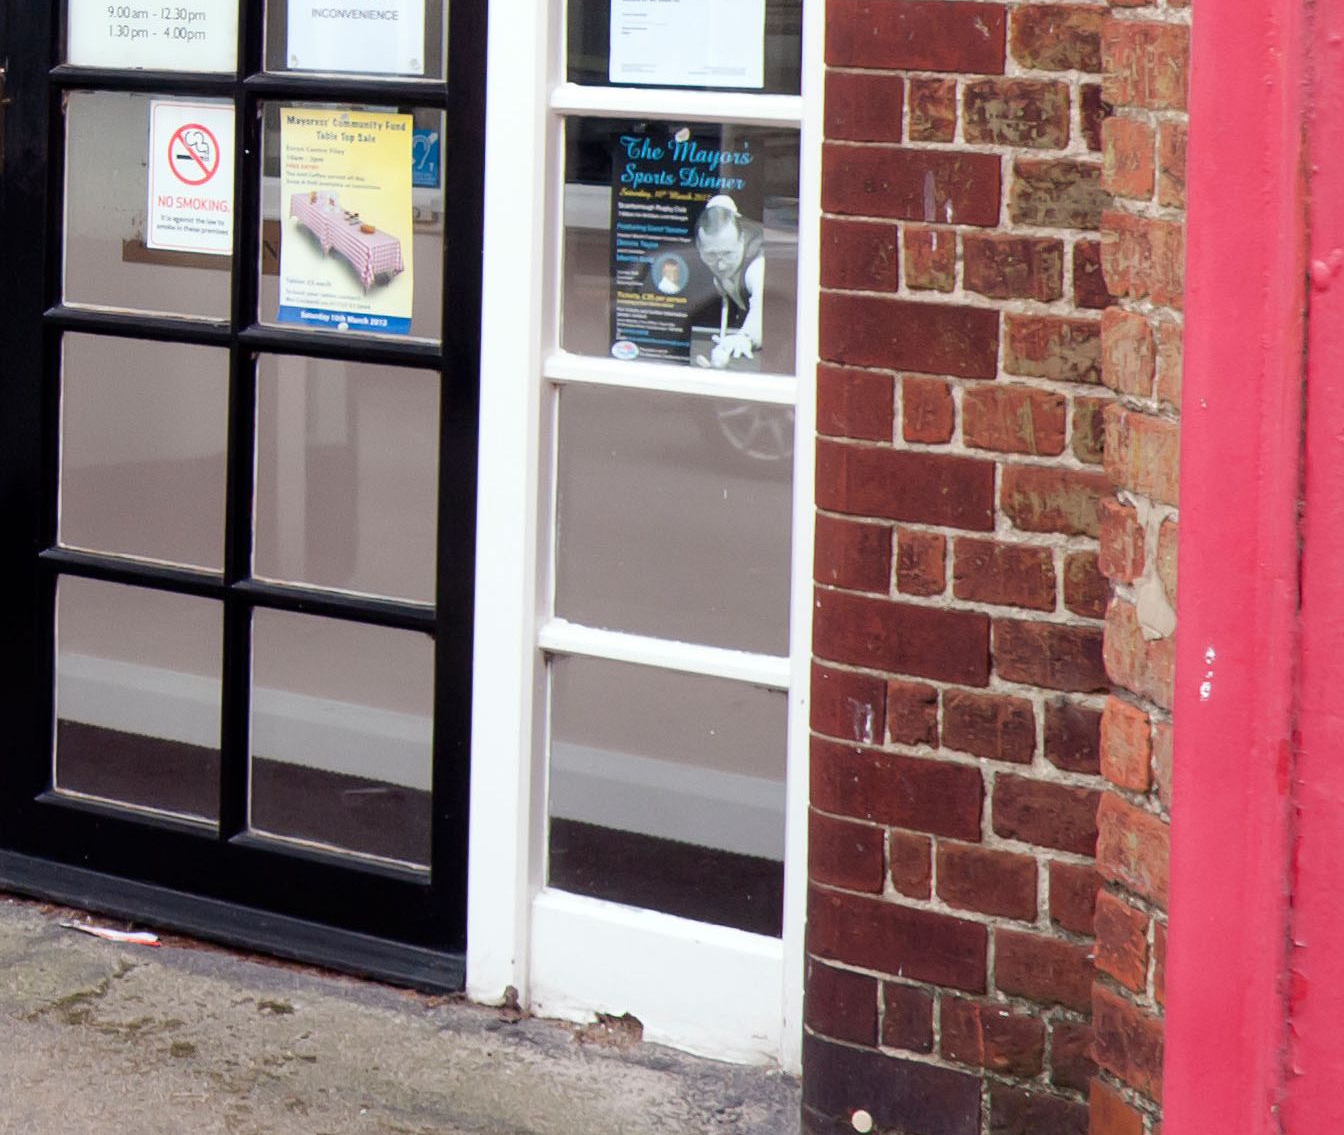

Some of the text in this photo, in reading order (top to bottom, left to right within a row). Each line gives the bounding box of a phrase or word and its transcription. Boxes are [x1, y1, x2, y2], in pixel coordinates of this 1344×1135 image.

[311, 8, 399, 21] INCONVENIENCE
[332, 118, 382, 130] Community
[385, 121, 406, 131] Fund
[316, 131, 376, 143] Table Top Sale
[620, 135, 664, 160] The
[620, 163, 745, 190] Sports Dinner
[158, 195, 173, 208] NO
